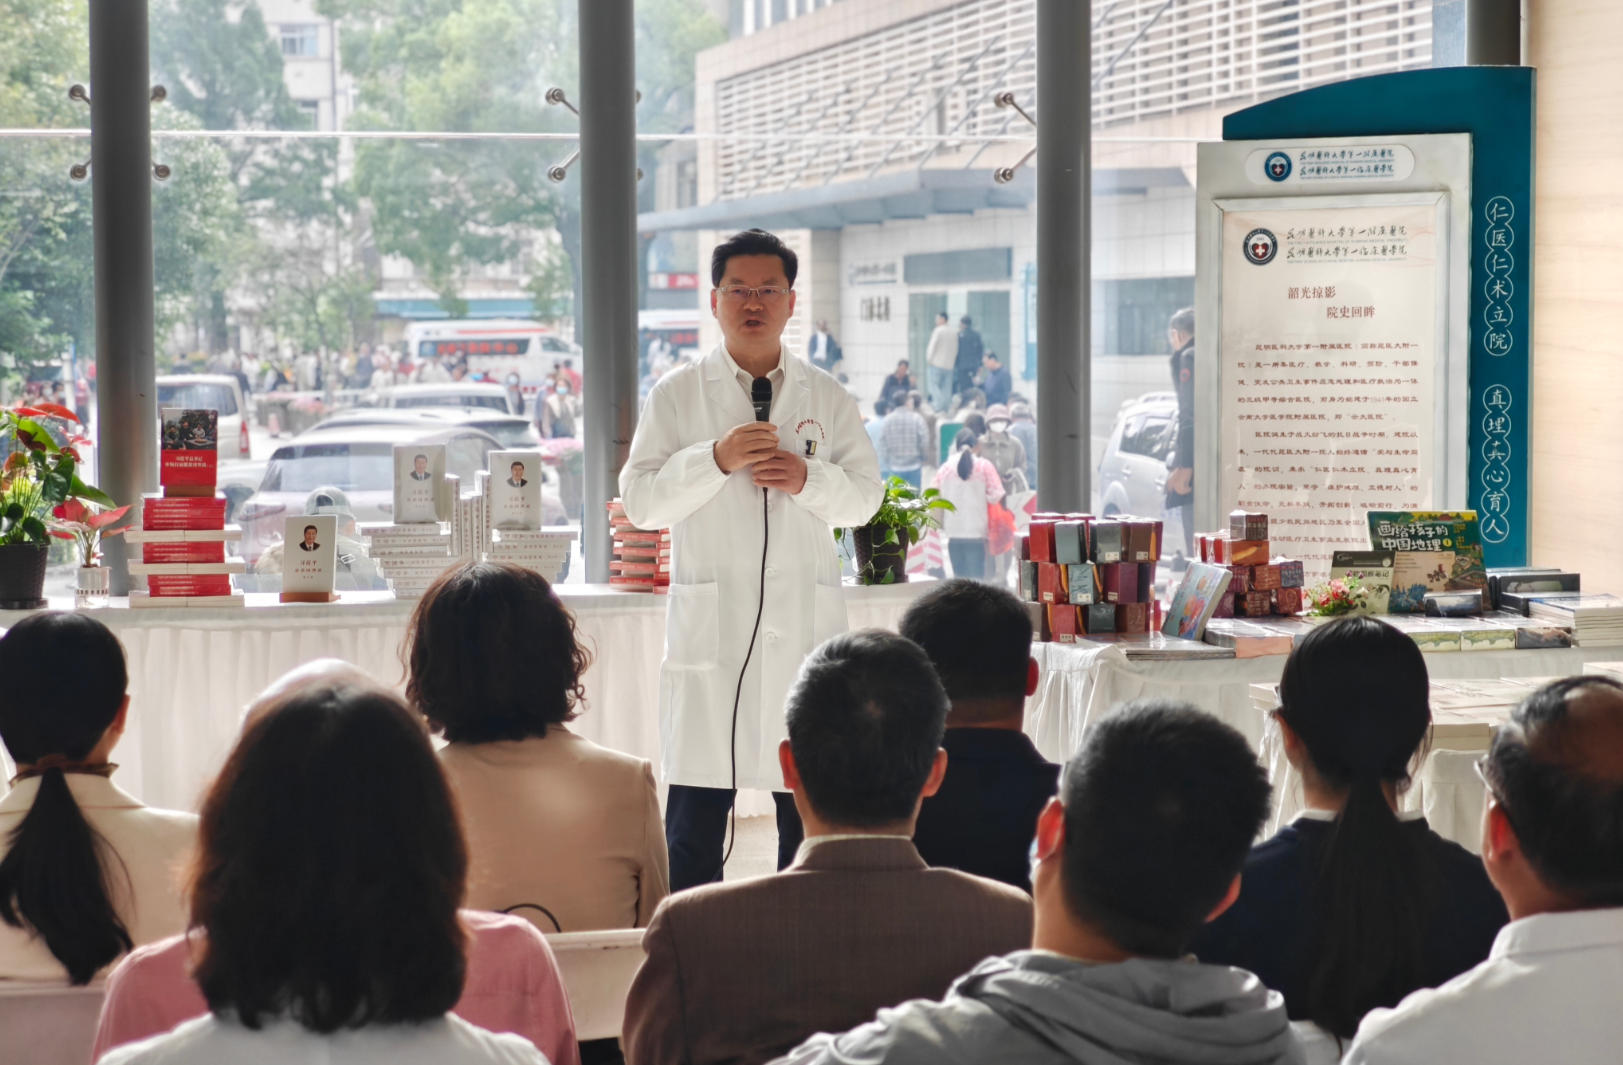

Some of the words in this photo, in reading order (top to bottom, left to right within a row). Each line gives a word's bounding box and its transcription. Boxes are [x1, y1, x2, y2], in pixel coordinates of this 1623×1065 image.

[1489, 202, 1509, 350] 仁医仁术立院
[1288, 286, 1336, 299] 韶光掠影
[1327, 305, 1375, 319] 院史回眸
[1378, 520, 1448, 538] 画给孩子的
[1382, 538, 1442, 551] 中国地理
